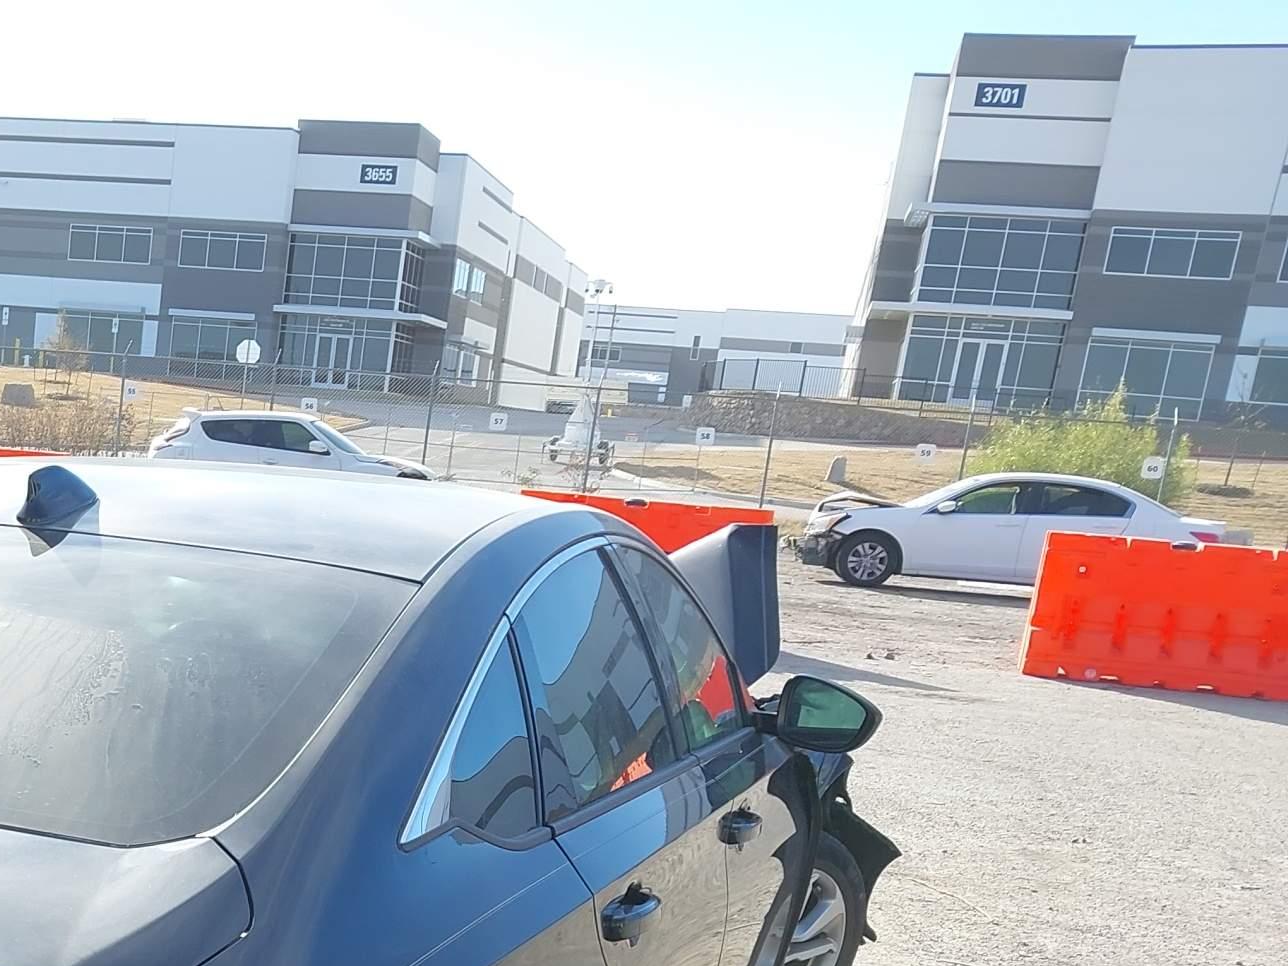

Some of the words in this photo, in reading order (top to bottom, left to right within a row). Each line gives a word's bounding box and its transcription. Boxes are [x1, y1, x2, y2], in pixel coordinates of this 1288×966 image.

[982, 86, 1020, 105] 3701
[364, 167, 393, 182] 3655
[494, 417, 504, 425] 57
[919, 449, 931, 457] 59
